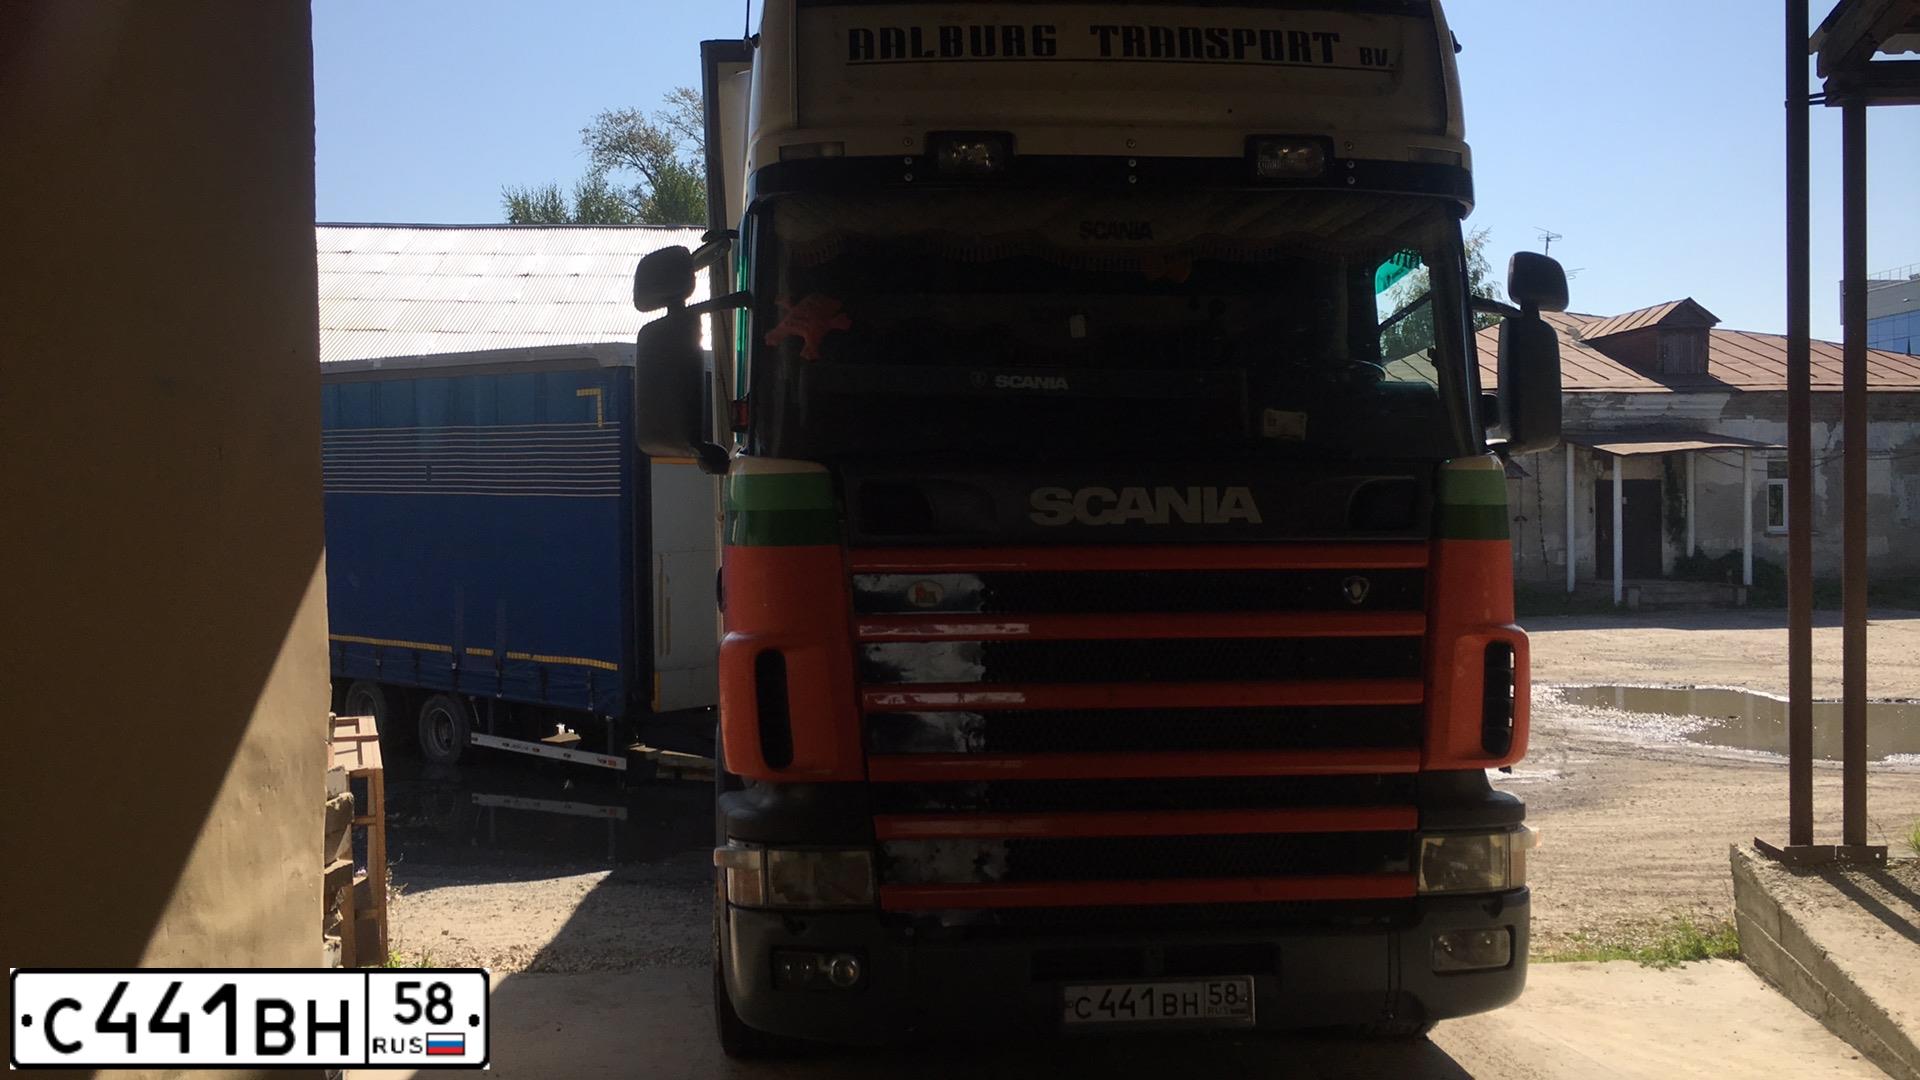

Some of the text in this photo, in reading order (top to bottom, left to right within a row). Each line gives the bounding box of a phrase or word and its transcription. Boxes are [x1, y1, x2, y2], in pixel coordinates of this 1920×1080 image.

[848, 25, 1057, 61] AALBURG
[1089, 25, 1341, 65] TRANSPORT
[993, 374, 1070, 390] SCANIA
[1028, 486, 1264, 526] SCANIA
[1208, 983, 1239, 1005] 58
